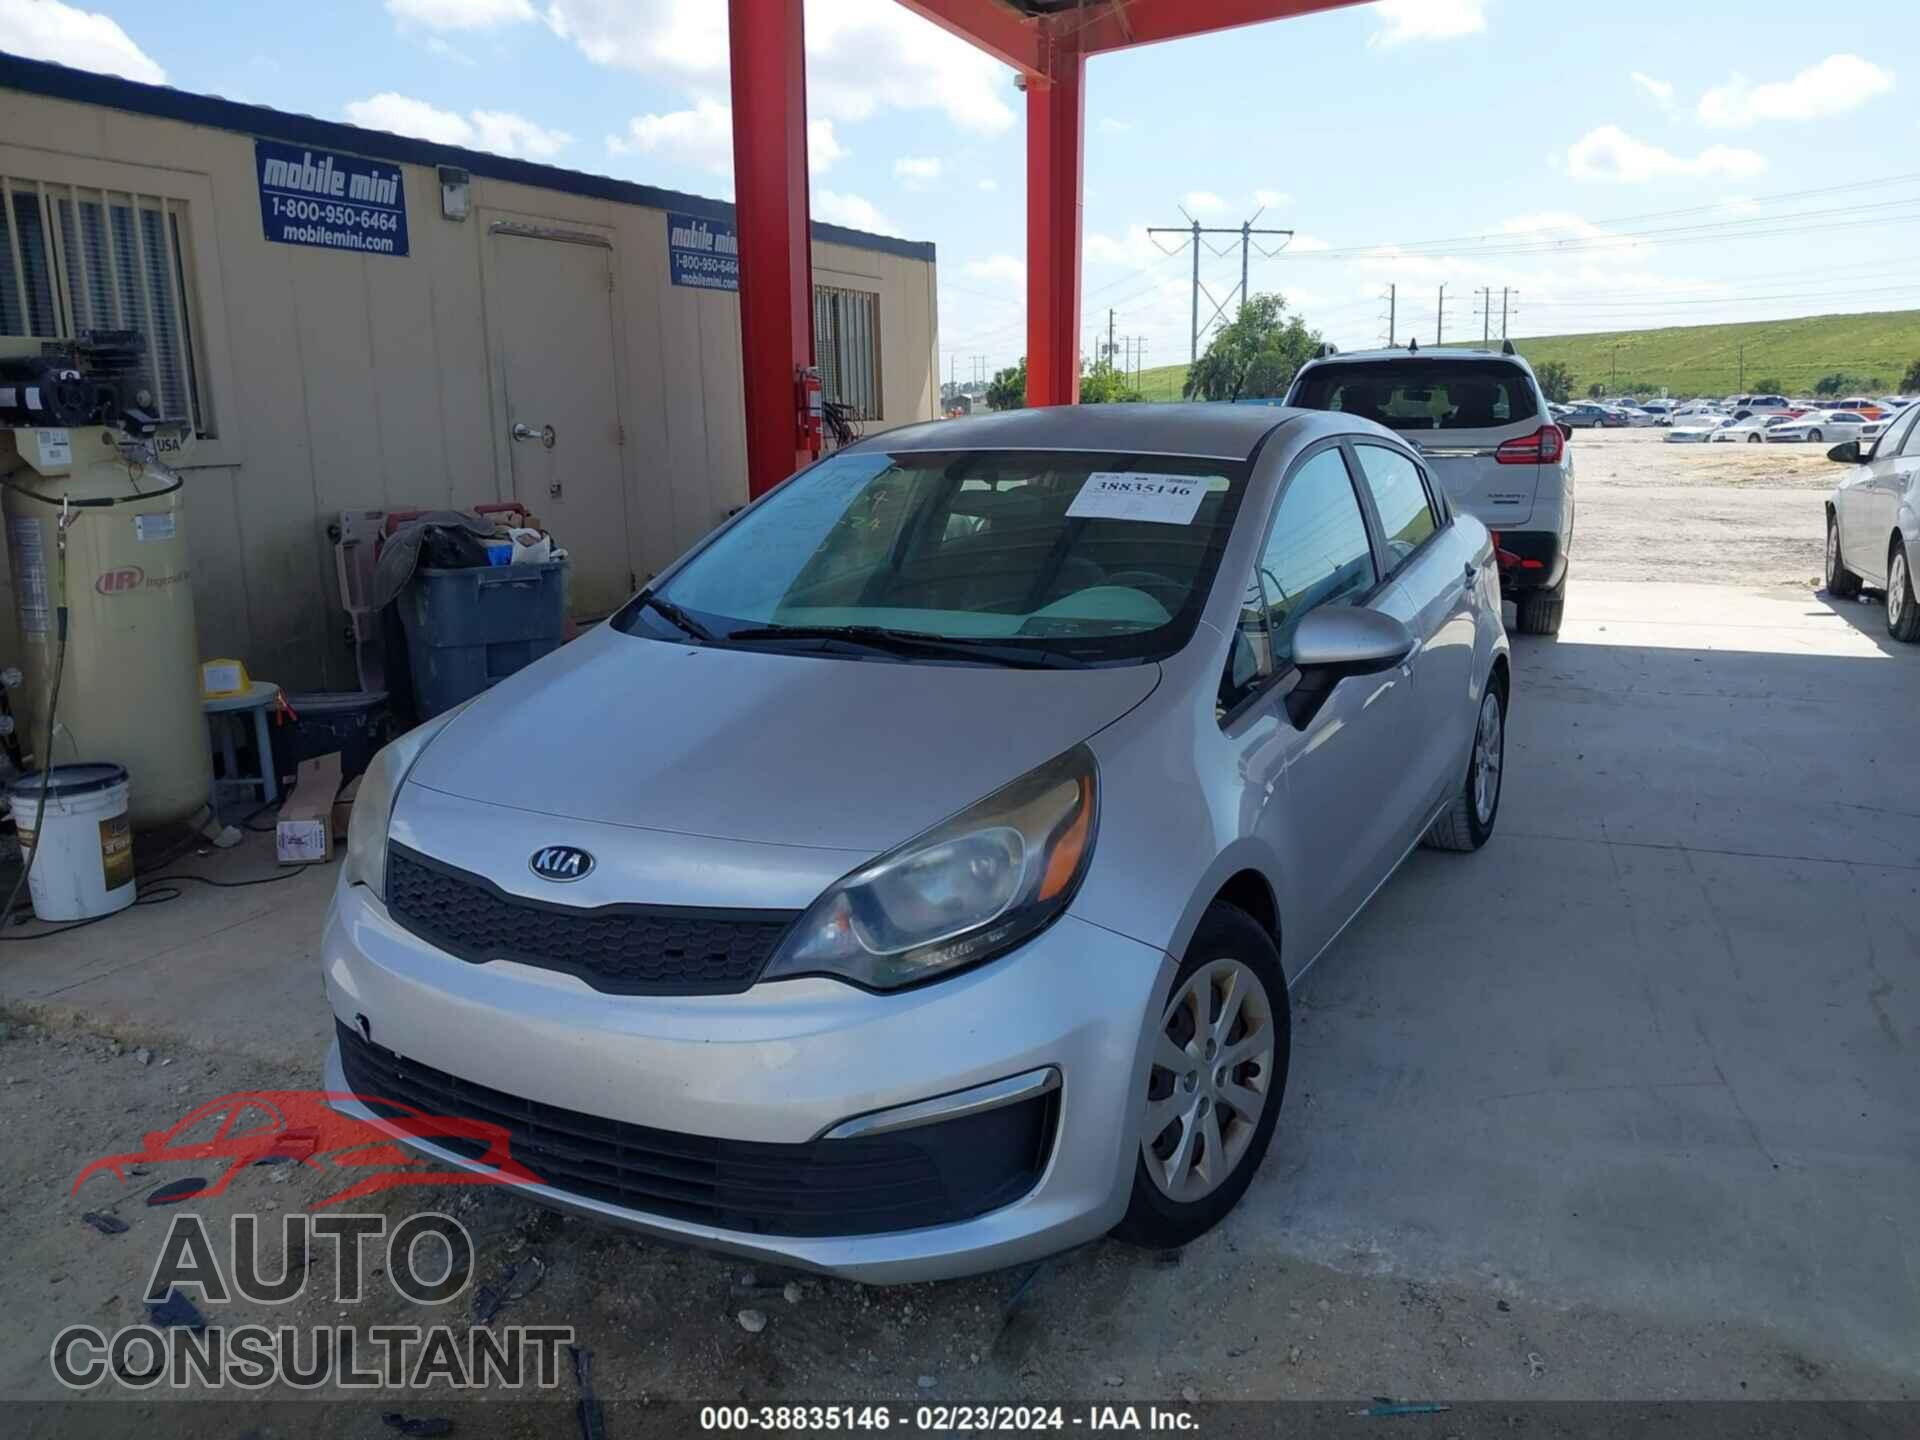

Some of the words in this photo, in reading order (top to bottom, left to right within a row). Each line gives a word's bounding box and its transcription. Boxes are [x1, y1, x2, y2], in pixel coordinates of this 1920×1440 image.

[263, 152, 346, 197] mobile
[350, 170, 399, 205] mini
[272, 196, 398, 232] 1-800-950-6464
[282, 224, 394, 252] mobilemini.com
[671, 220, 713, 251] mobile
[714, 230, 738, 254] min
[1099, 481, 1191, 496] 38835146
[535, 848, 582, 875] KIA
